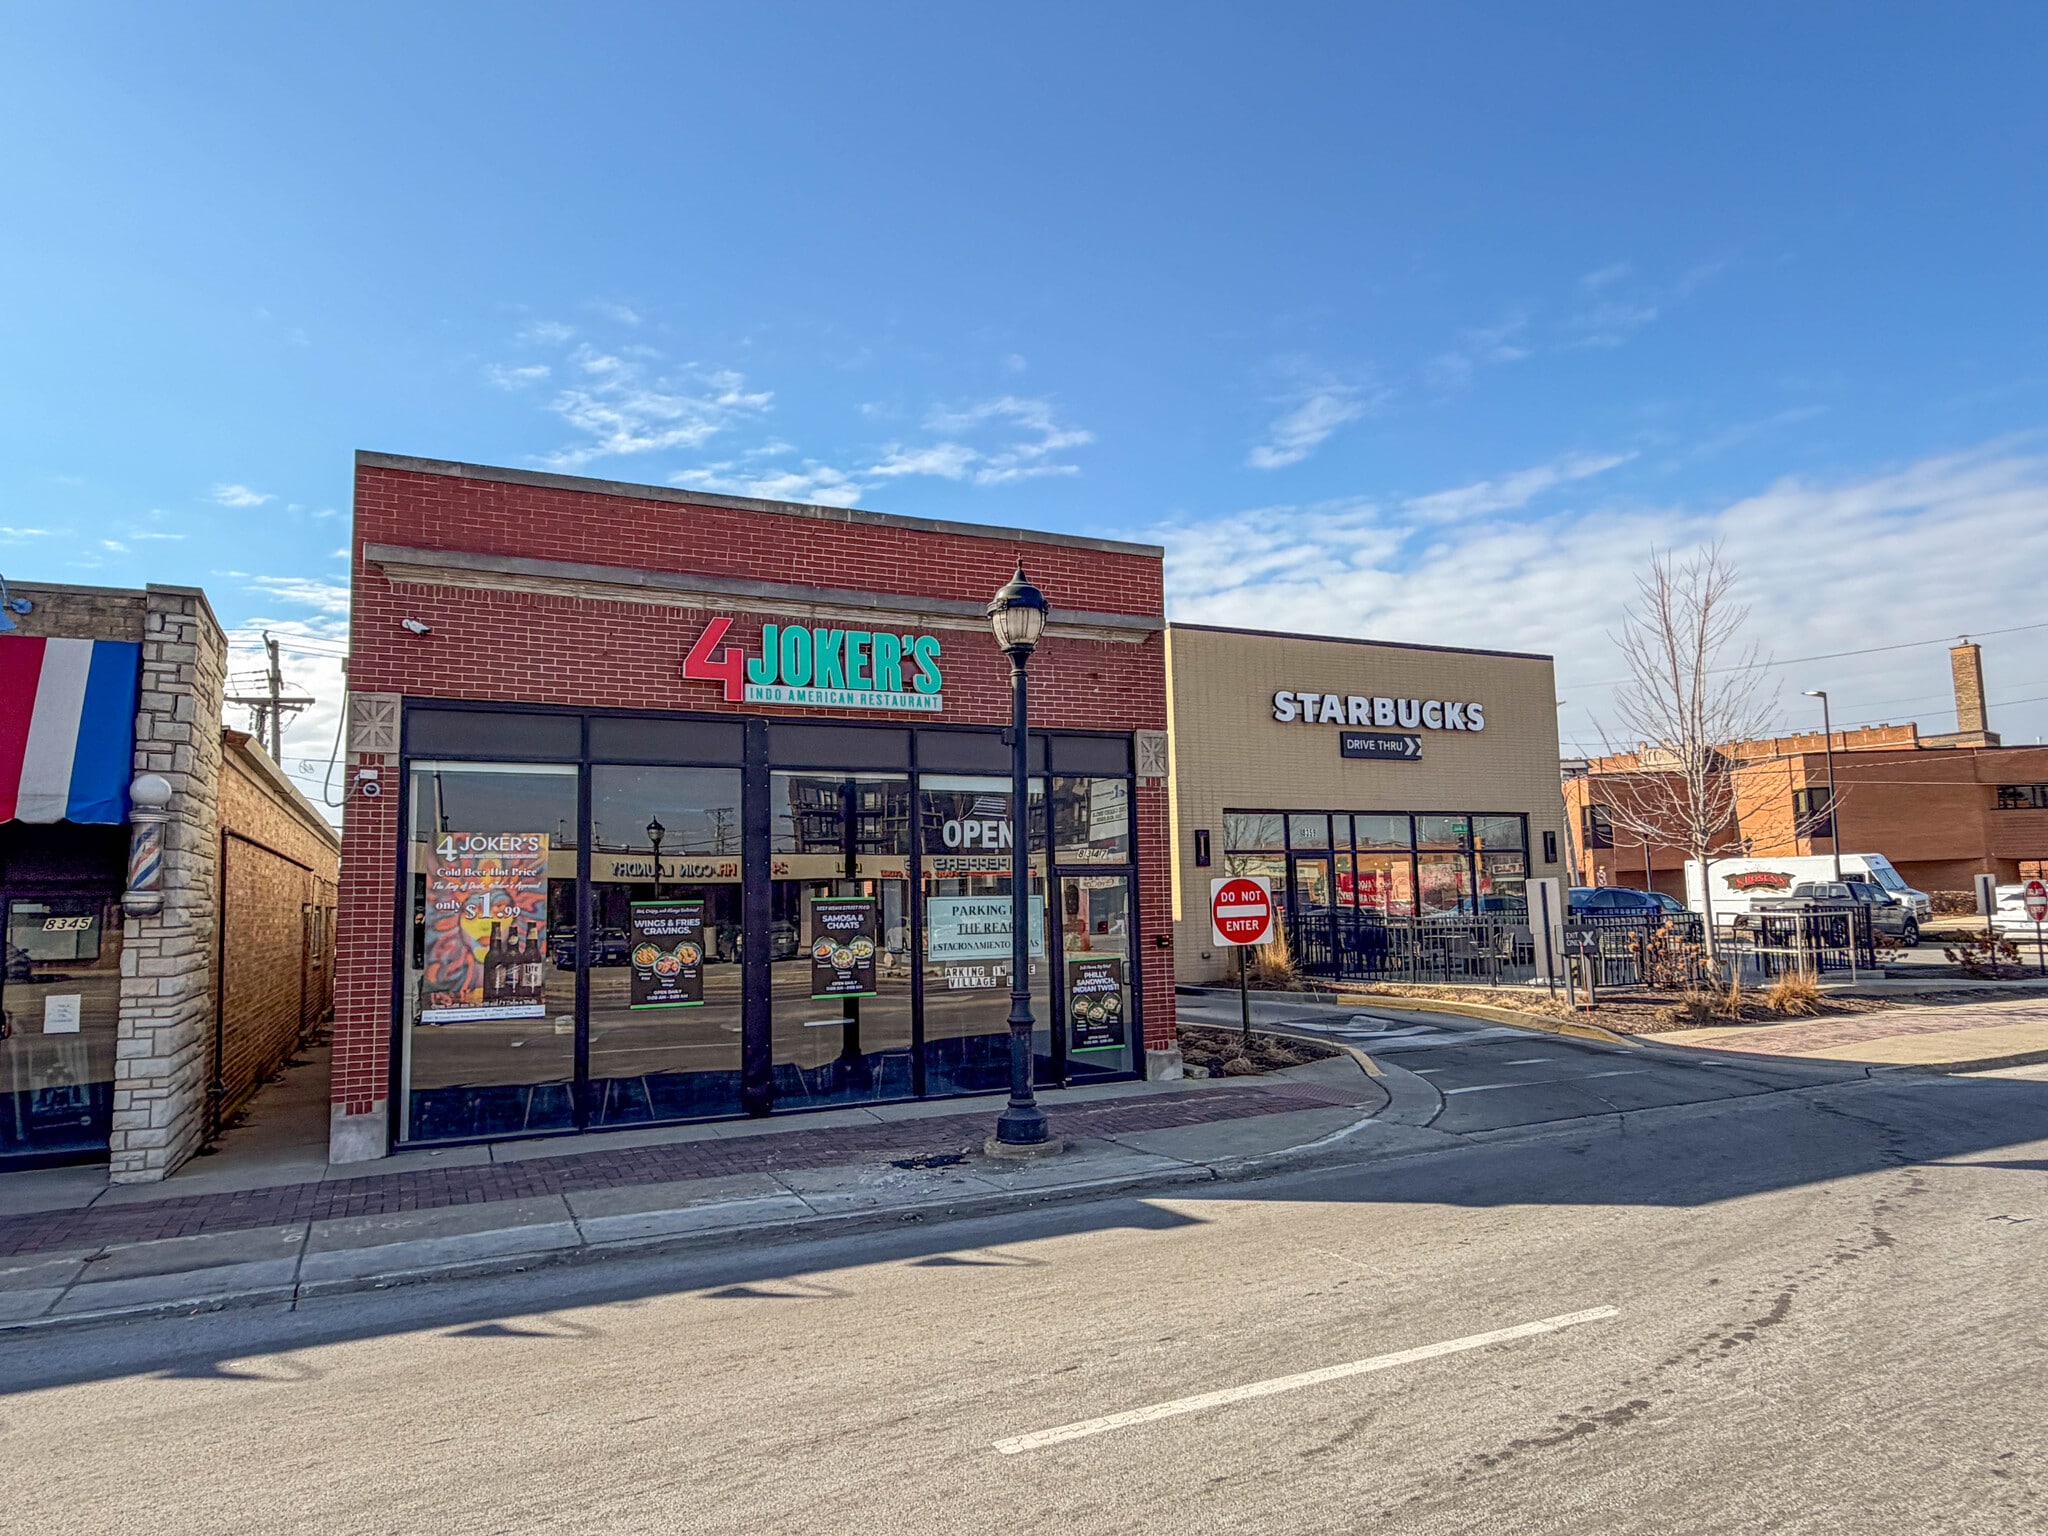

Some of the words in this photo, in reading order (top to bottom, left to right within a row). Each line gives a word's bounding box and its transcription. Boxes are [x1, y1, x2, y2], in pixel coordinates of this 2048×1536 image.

[682, 616, 744, 702] 4
[747, 623, 942, 694] JOKER'S
[750, 687, 782, 701] INDO
[788, 689, 854, 705] AMERICAN
[860, 693, 938, 709] RESTAURANT
[1273, 690, 1485, 732] STARBUCKS
[1346, 738, 1375, 750] DRIVE
[1379, 739, 1403, 752] THRU
[942, 819, 1014, 849] OPEN
[436, 835, 458, 862] 4
[459, 836, 539, 852] JOKER'S
[1078, 849, 1108, 859] 8347
[436, 867, 461, 877] Cold
[464, 867, 487, 877] Beer
[511, 867, 537, 877] Price
[1220, 891, 1236, 903] DO
[1241, 890, 1262, 902] NOT
[435, 899, 463, 913] only
[952, 905, 1007, 917] PARKING
[45, 918, 90, 930] 8345
[634, 919, 666, 929] WINGS
[667, 919, 674, 928] &
[675, 918, 701, 927] FRIES
[822, 914, 857, 923] SAMOSA
[857, 914, 865, 922] &
[827, 921, 860, 930] CHAATS
[957, 923, 980, 935] THE
[1226, 919, 1260, 932] ENTER
[933, 940, 1011, 952] ESTACIONAMIENTO
[1083, 970, 1108, 979] PHILLY
[949, 977, 996, 988] VILLAGE
